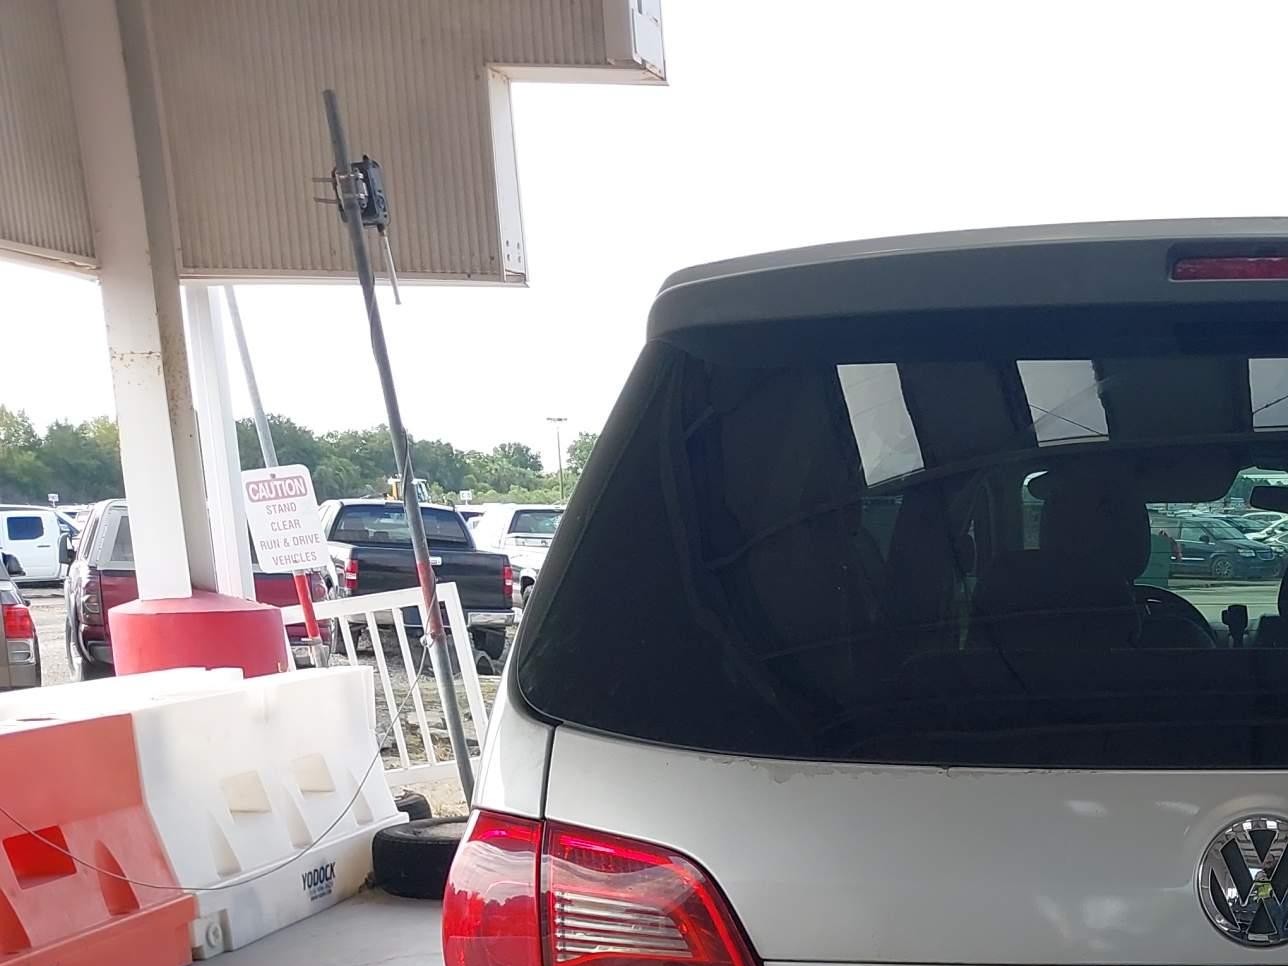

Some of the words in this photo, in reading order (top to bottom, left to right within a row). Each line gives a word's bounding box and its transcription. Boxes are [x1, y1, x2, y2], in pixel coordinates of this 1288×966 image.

[248, 478, 306, 500] CAUTION
[265, 502, 297, 515] STAND
[270, 519, 301, 532] CLEAR
[260, 540, 280, 551] RUN
[283, 538, 290, 548] &
[292, 533, 320, 546] DRIVE
[272, 551, 318, 566] VEHICLES
[302, 861, 336, 891] YODOCK
